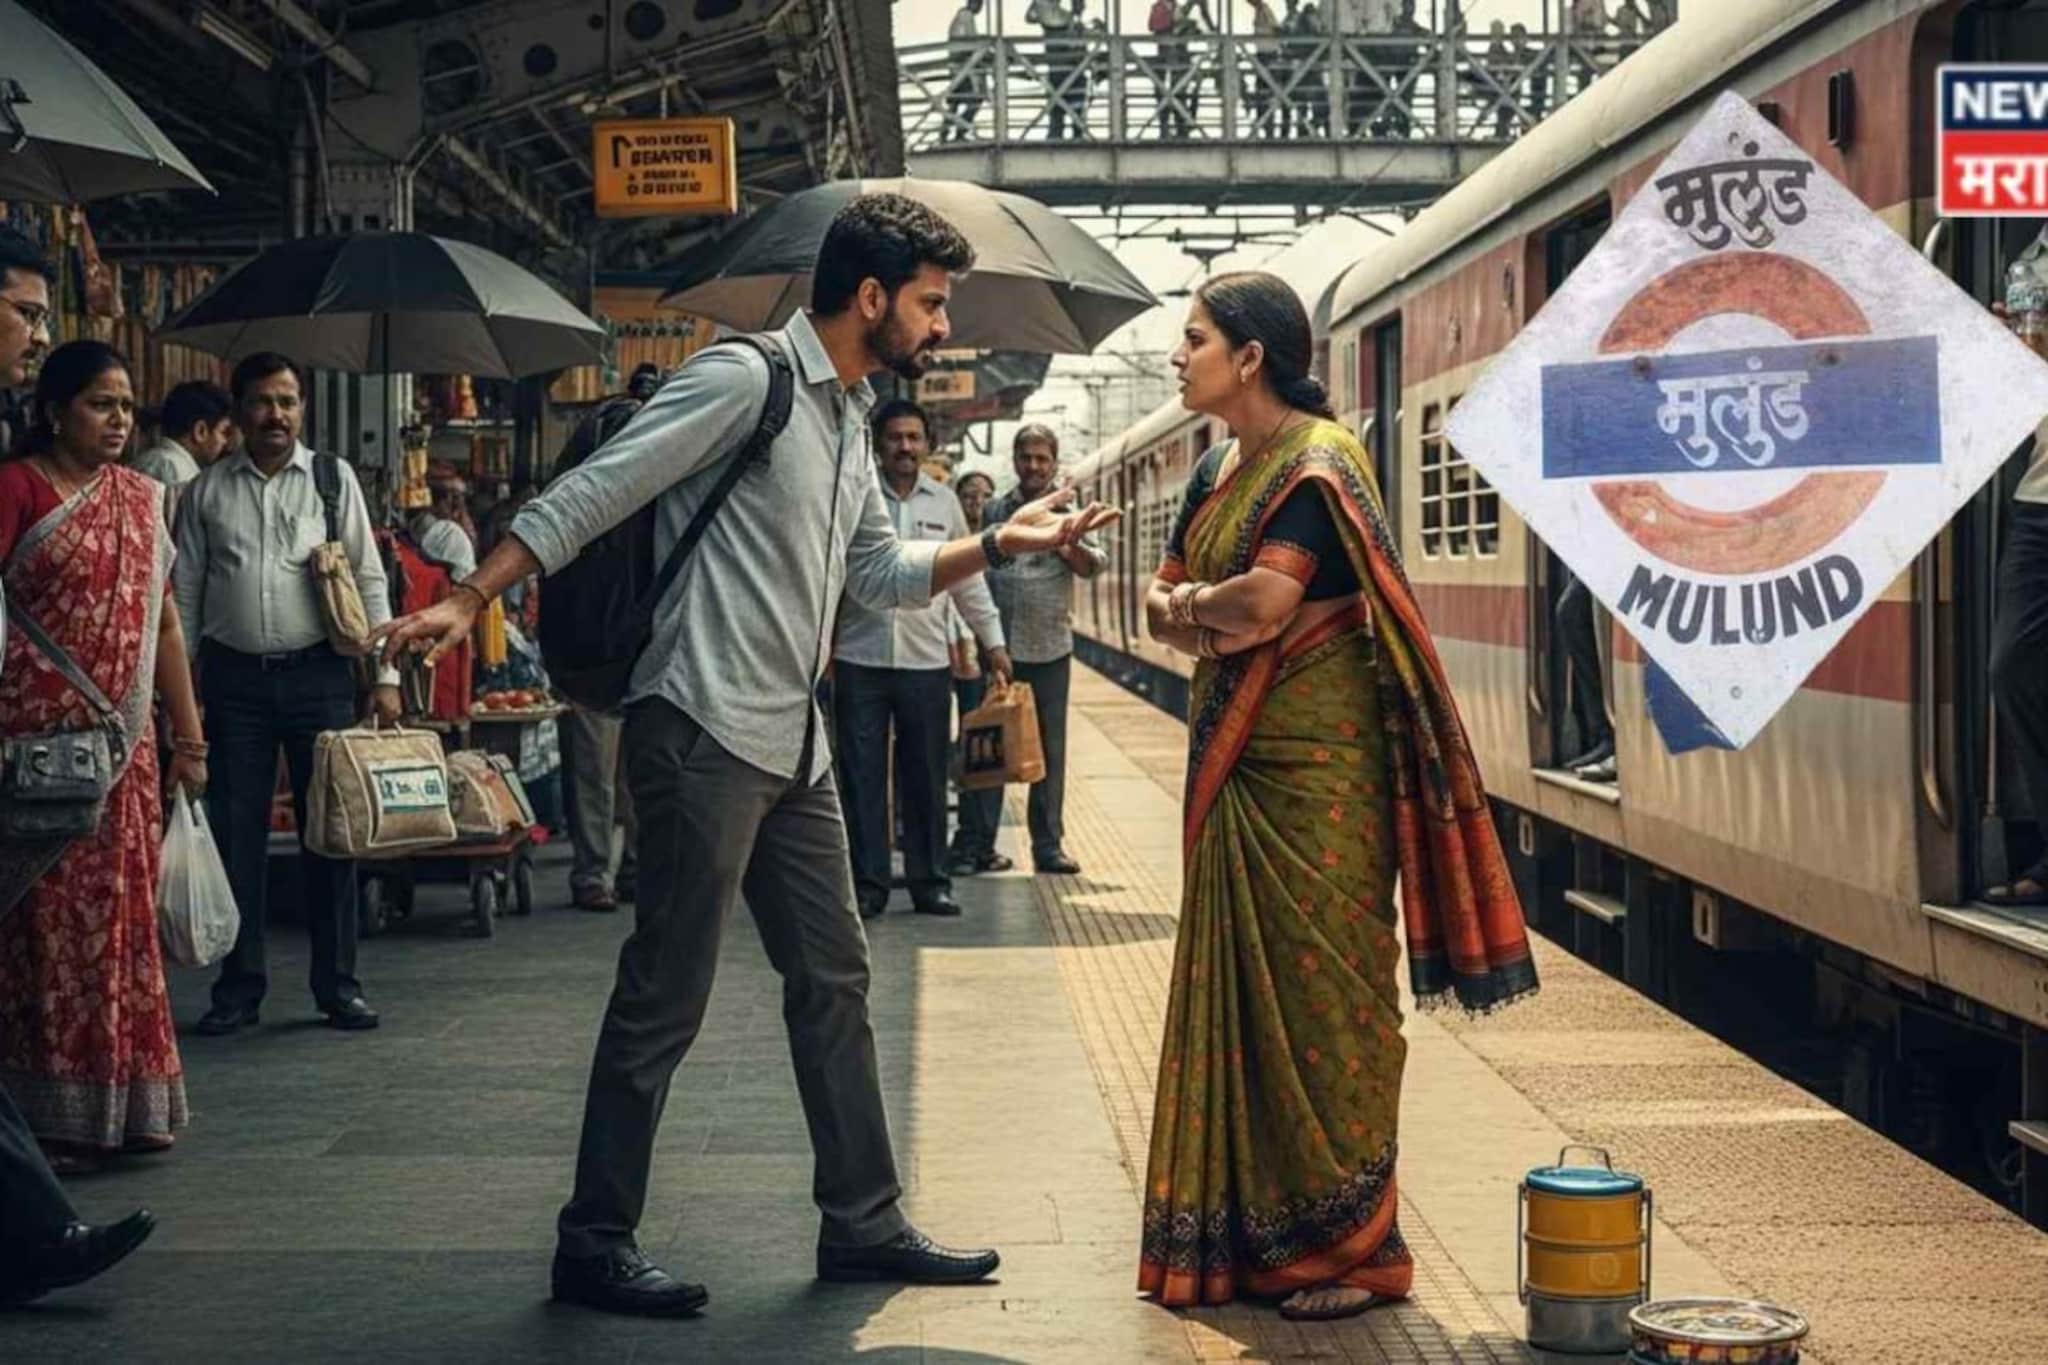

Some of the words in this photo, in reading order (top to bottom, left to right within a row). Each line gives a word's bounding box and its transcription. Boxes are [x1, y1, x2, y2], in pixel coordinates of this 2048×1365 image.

[1655, 141, 1815, 250] मुलुंड
[1656, 355, 1809, 468] मुलुंड
[1616, 554, 1864, 645] MULUND
